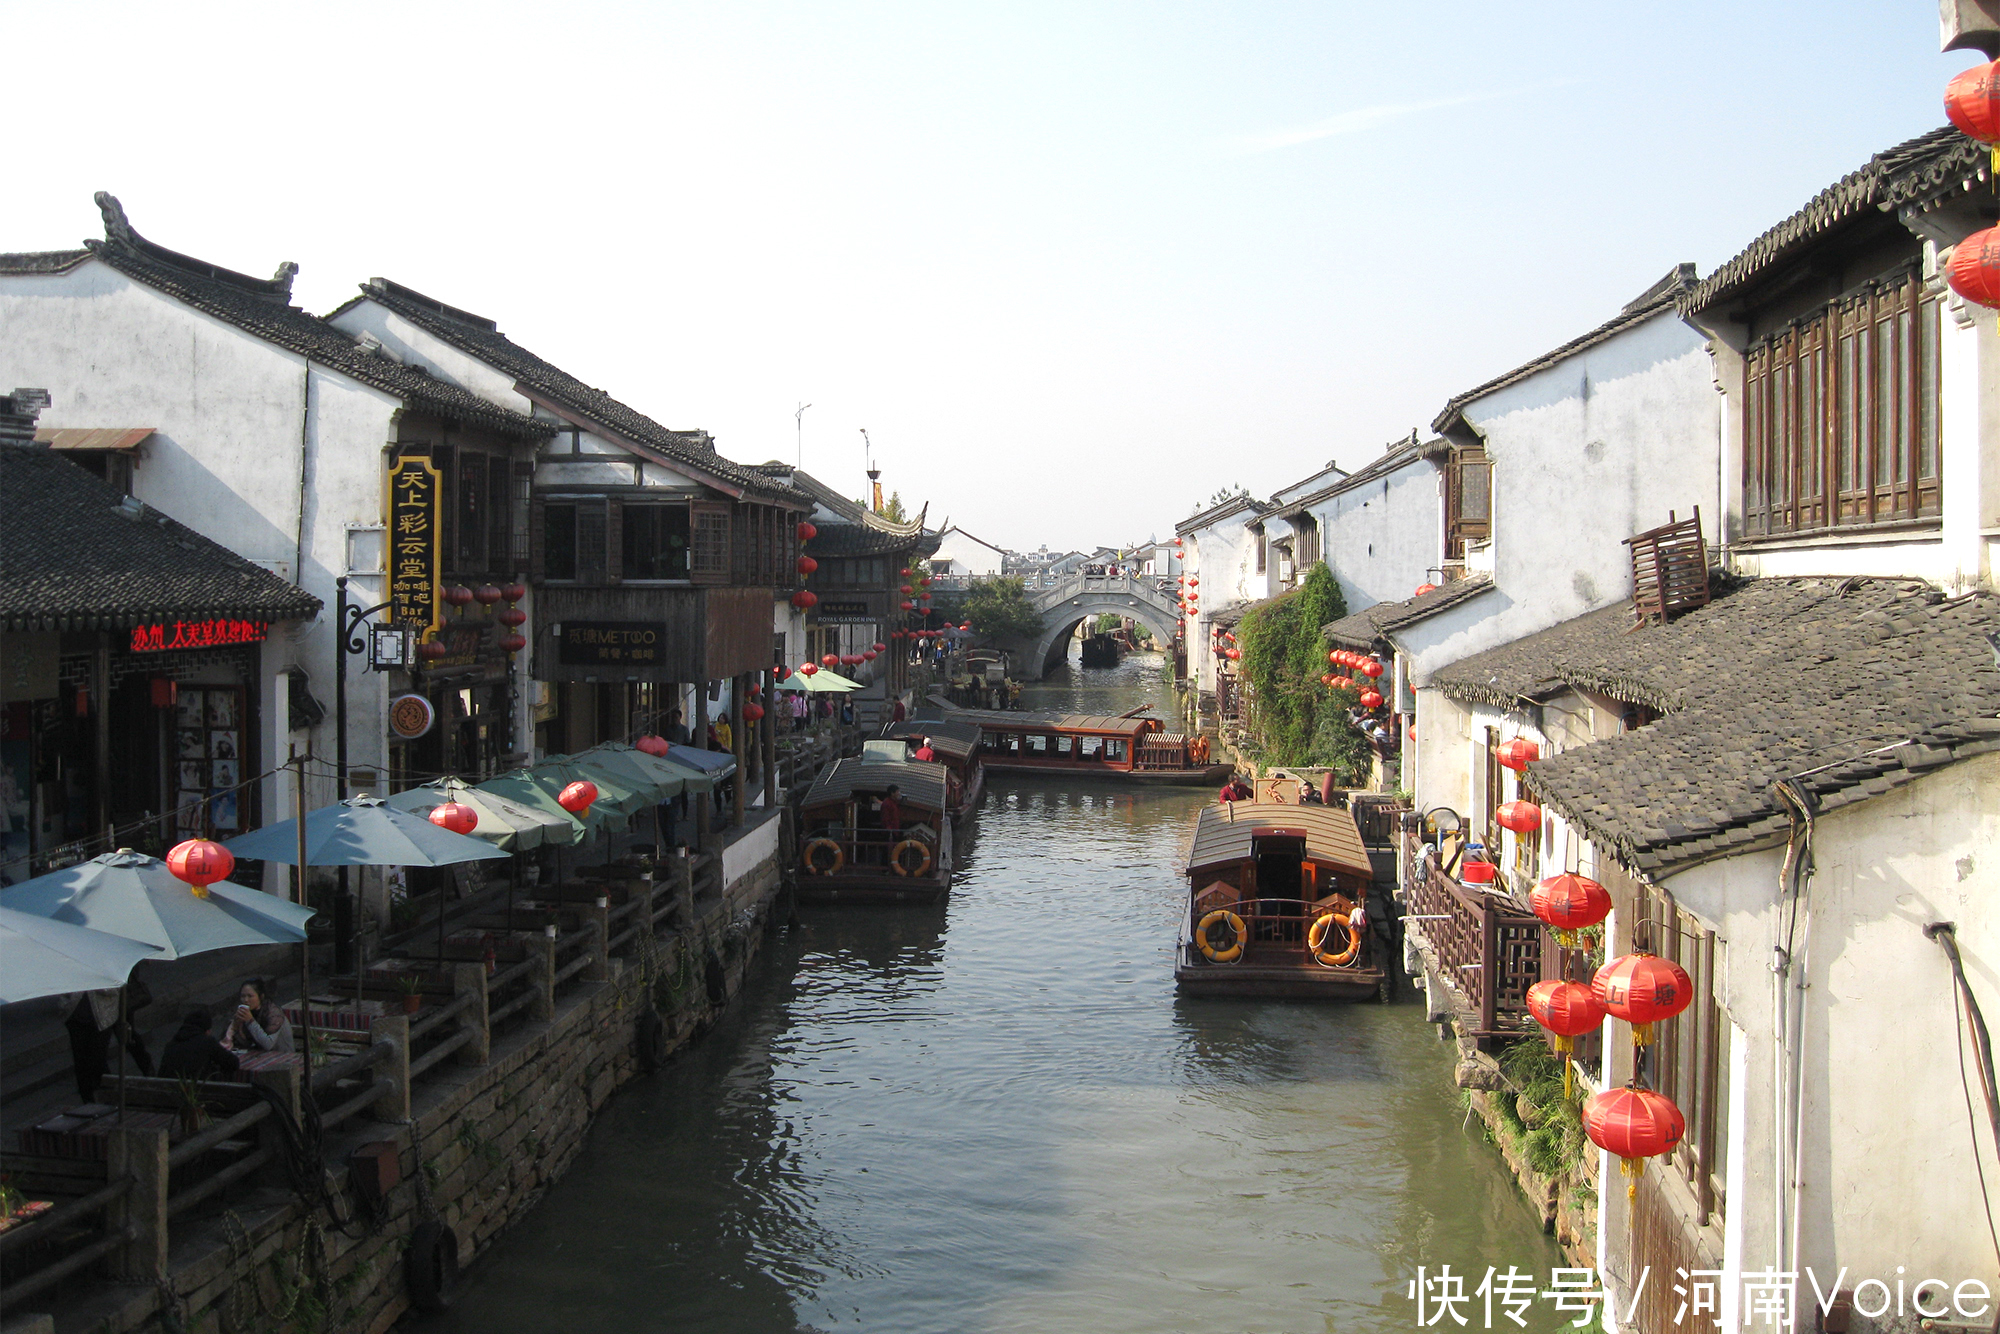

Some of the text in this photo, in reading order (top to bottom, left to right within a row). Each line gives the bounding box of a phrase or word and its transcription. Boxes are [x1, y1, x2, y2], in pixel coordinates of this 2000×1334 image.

[397, 471, 428, 579] 天上彩云堂
[393, 580, 431, 592] 咖啡
[401, 606, 424, 616] Bar
[1603, 984, 1678, 1007] 山 塘
